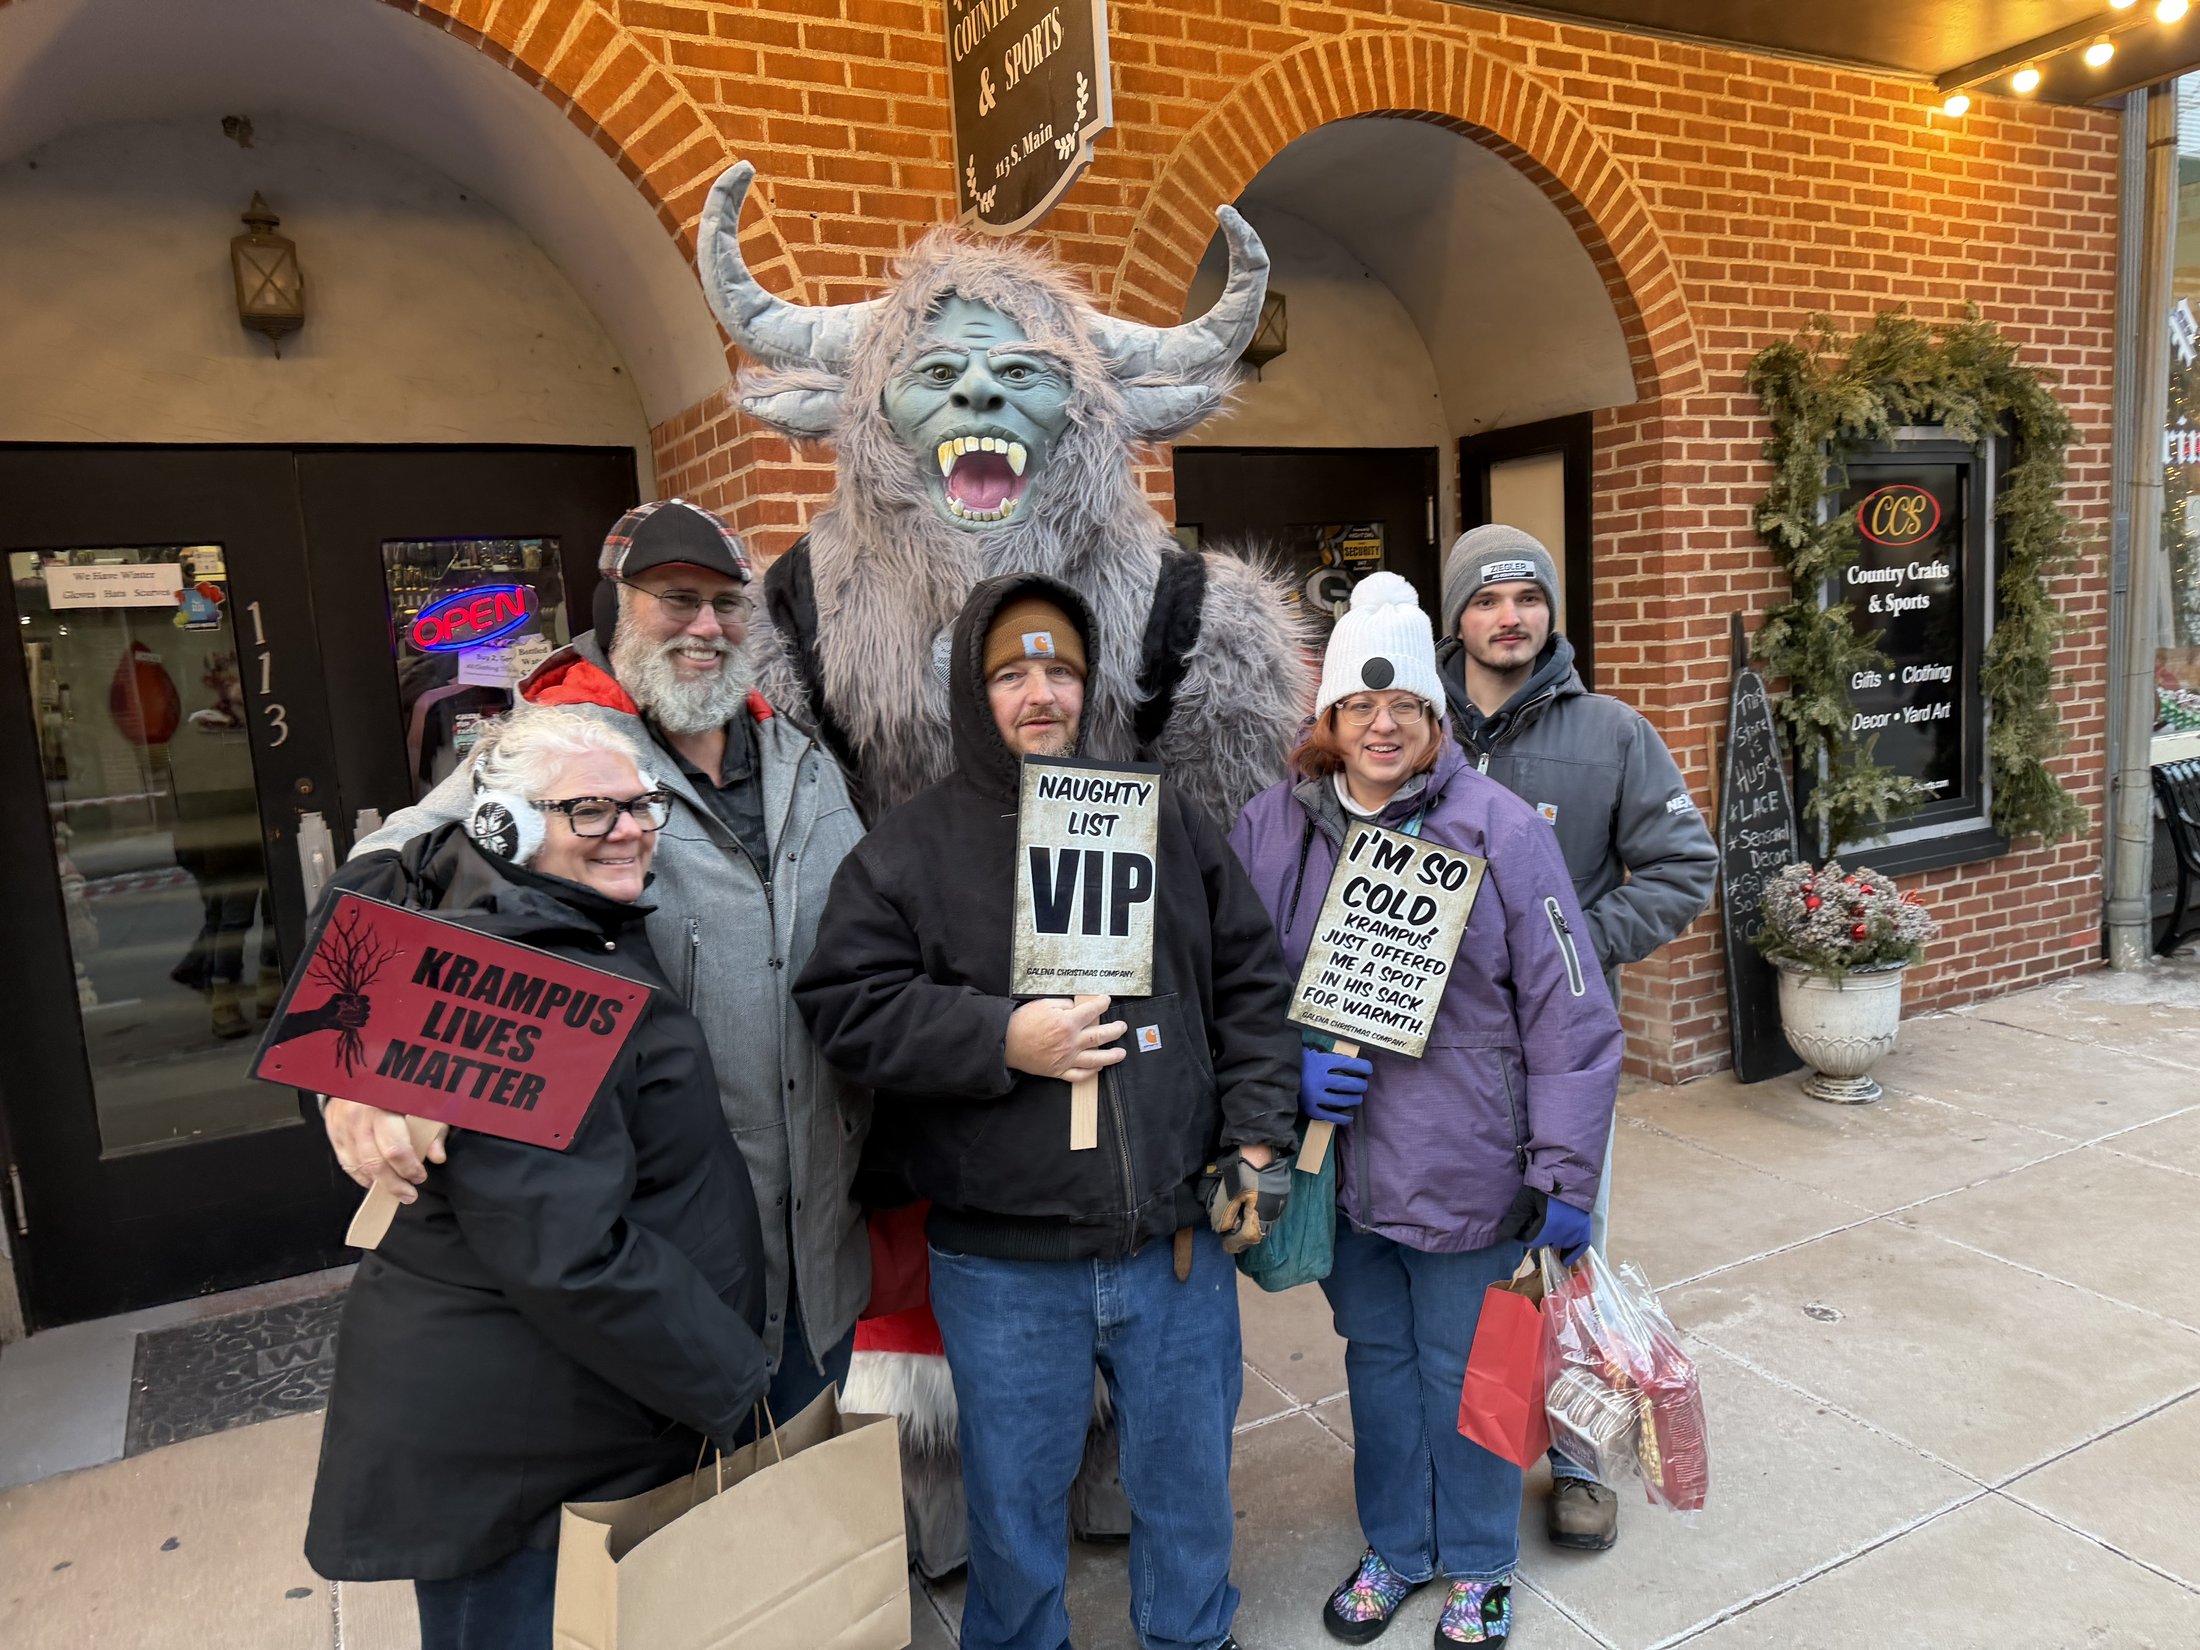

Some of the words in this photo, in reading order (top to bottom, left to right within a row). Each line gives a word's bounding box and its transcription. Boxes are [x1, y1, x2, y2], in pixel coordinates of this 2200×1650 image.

[978, 66, 996, 117] &
[1004, 6, 1063, 92] SPORTS
[995, 155, 1010, 179] 113
[1010, 144, 1022, 167] S.
[1021, 122, 1054, 159] Main
[1872, 494, 1927, 538] CCS
[1344, 545, 1380, 557] SECURITY
[72, 572, 91, 581] We
[93, 571, 118, 580] Have
[120, 570, 156, 580] Winter
[1847, 565, 1906, 588] Country
[1907, 560, 1950, 580] Crafts
[63, 591, 96, 600] Gloves
[104, 590, 127, 599] Hats
[134, 588, 171, 598] Scarves
[1868, 594, 1884, 613] &
[1885, 592, 1930, 618] Sports
[412, 587, 527, 647] OPEN
[1851, 670, 1882, 690] Gifts
[1902, 662, 1953, 684] Clothing
[1735, 718, 1769, 748] Store
[1851, 713, 1892, 731] Decor
[1902, 703, 1932, 724] Yard
[1931, 701, 1952, 720] Art
[1039, 774, 1152, 806] NAUGHTY
[1068, 811, 1120, 837] LIST
[1348, 830, 1417, 876] I'M
[1417, 852, 1469, 892] SO
[1750, 849, 1790, 869] Decor
[1029, 846, 1152, 937] VIP
[1344, 912, 1432, 950] KRAMPUS
[1322, 928, 1368, 951] JUST
[1371, 942, 1446, 976] OFFERED
[1026, 967, 1055, 976] GALENA
[1056, 968, 1098, 977] CHRISTMAS
[1099, 969, 1135, 978] COMPANY
[1329, 951, 1359, 971] ME
[1360, 961, 1375, 977] A
[1378, 965, 1427, 992] SPOT
[411, 946, 624, 1036] KRAMPUS
[1320, 970, 1340, 987] IN
[1343, 976, 1374, 998] HIS
[1376, 986, 1425, 1013] SACK
[1302, 986, 1338, 1009] FOR
[1342, 999, 1427, 1036] WARMTH.
[1302, 1011, 1329, 1025] GALENA
[1330, 1020, 1371, 1037] CHRISTMAS
[1371, 1032, 1408, 1048] COMPANY
[420, 1000, 543, 1063] LIVES
[376, 1038, 546, 1112] MATTER
